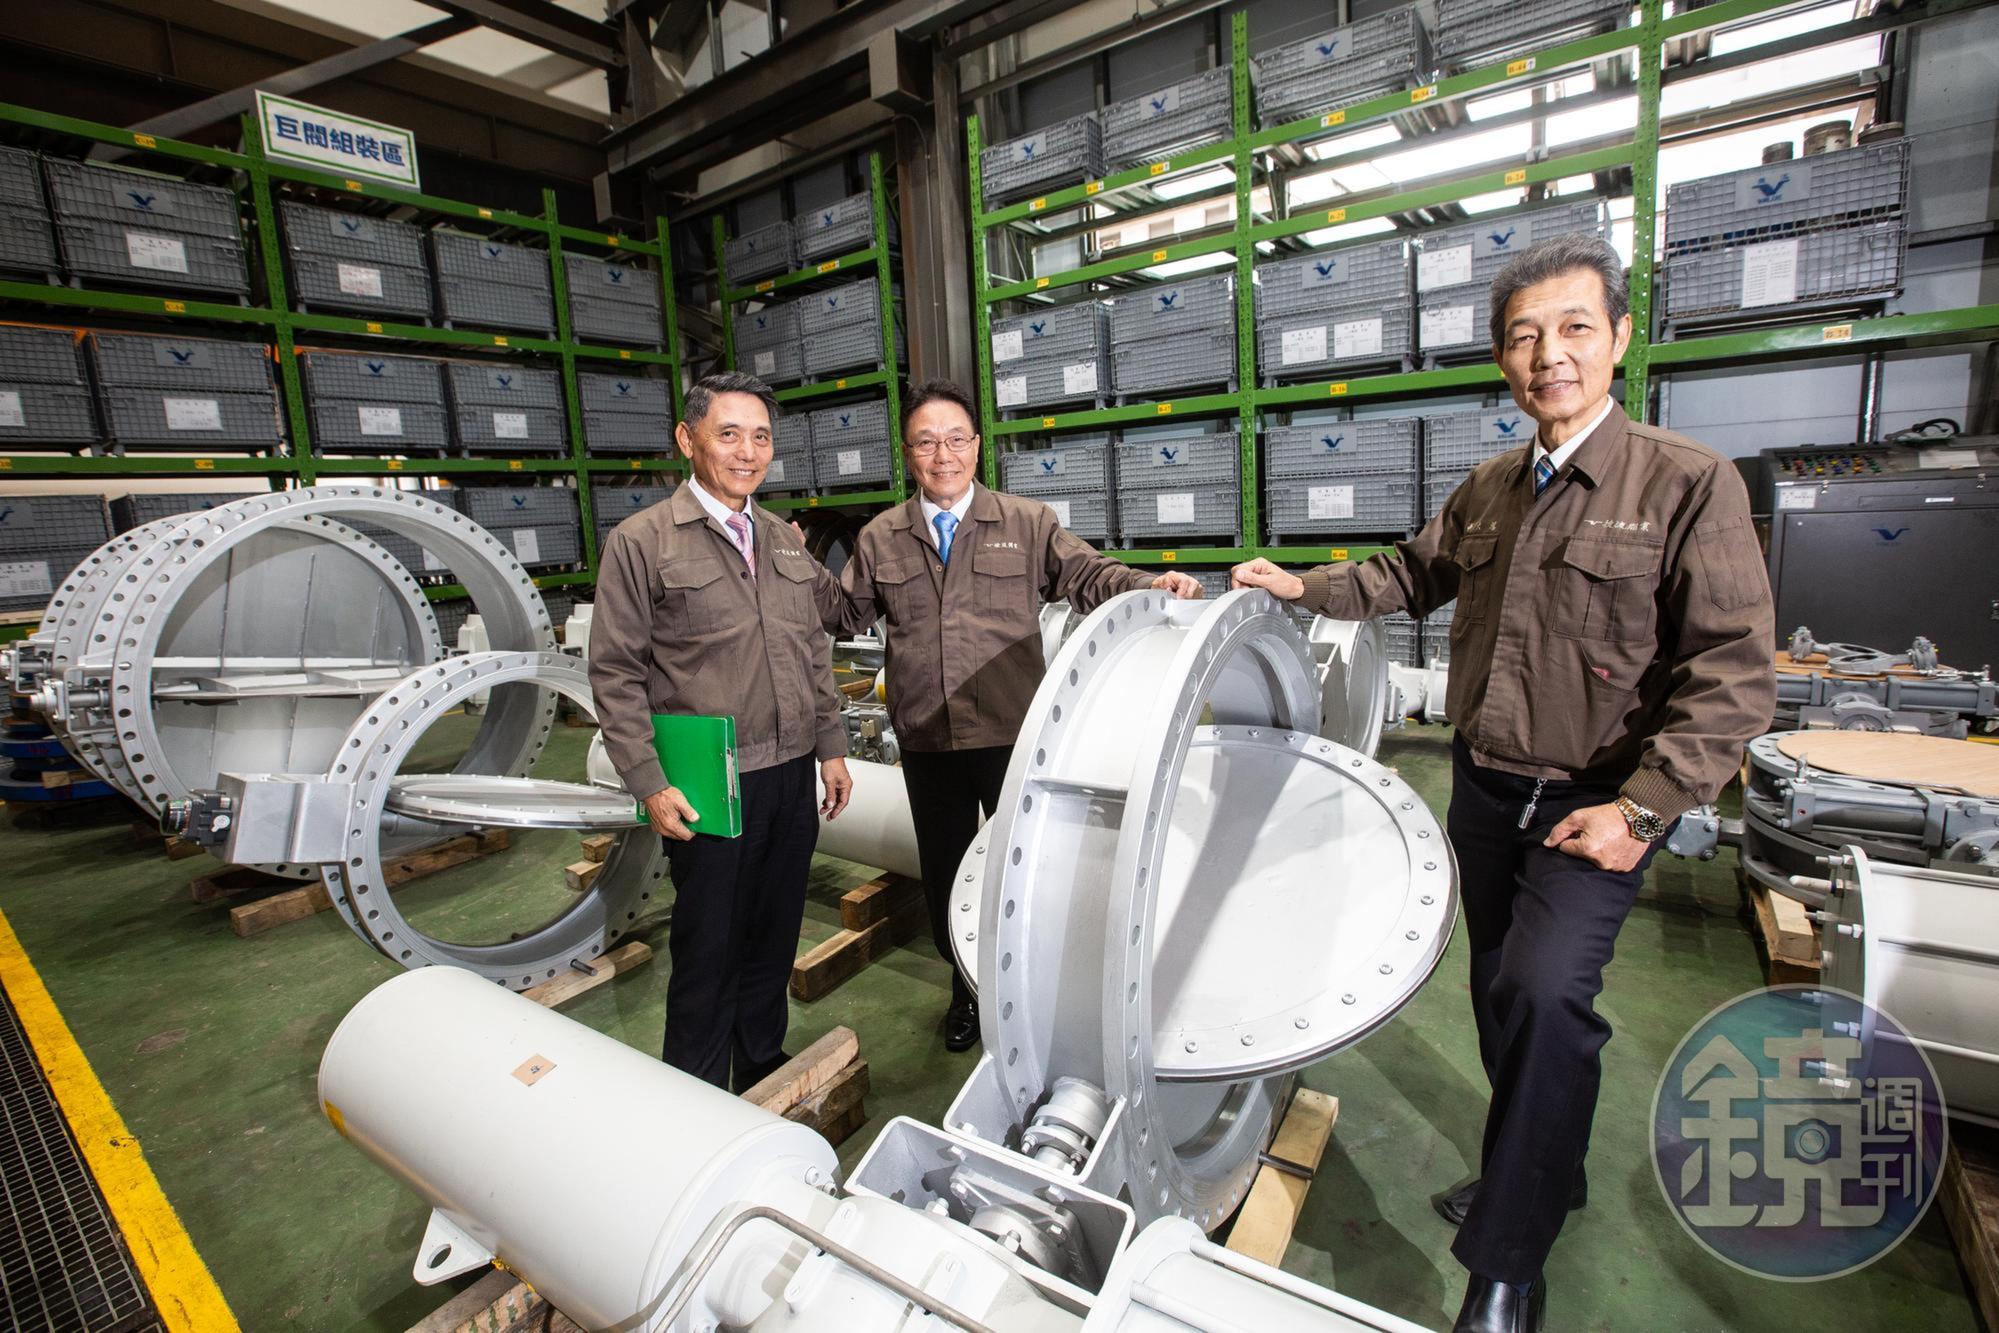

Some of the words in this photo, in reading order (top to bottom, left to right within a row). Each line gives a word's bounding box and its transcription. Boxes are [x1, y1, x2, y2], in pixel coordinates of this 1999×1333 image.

[274, 113, 405, 167] 巨閥組裝區
